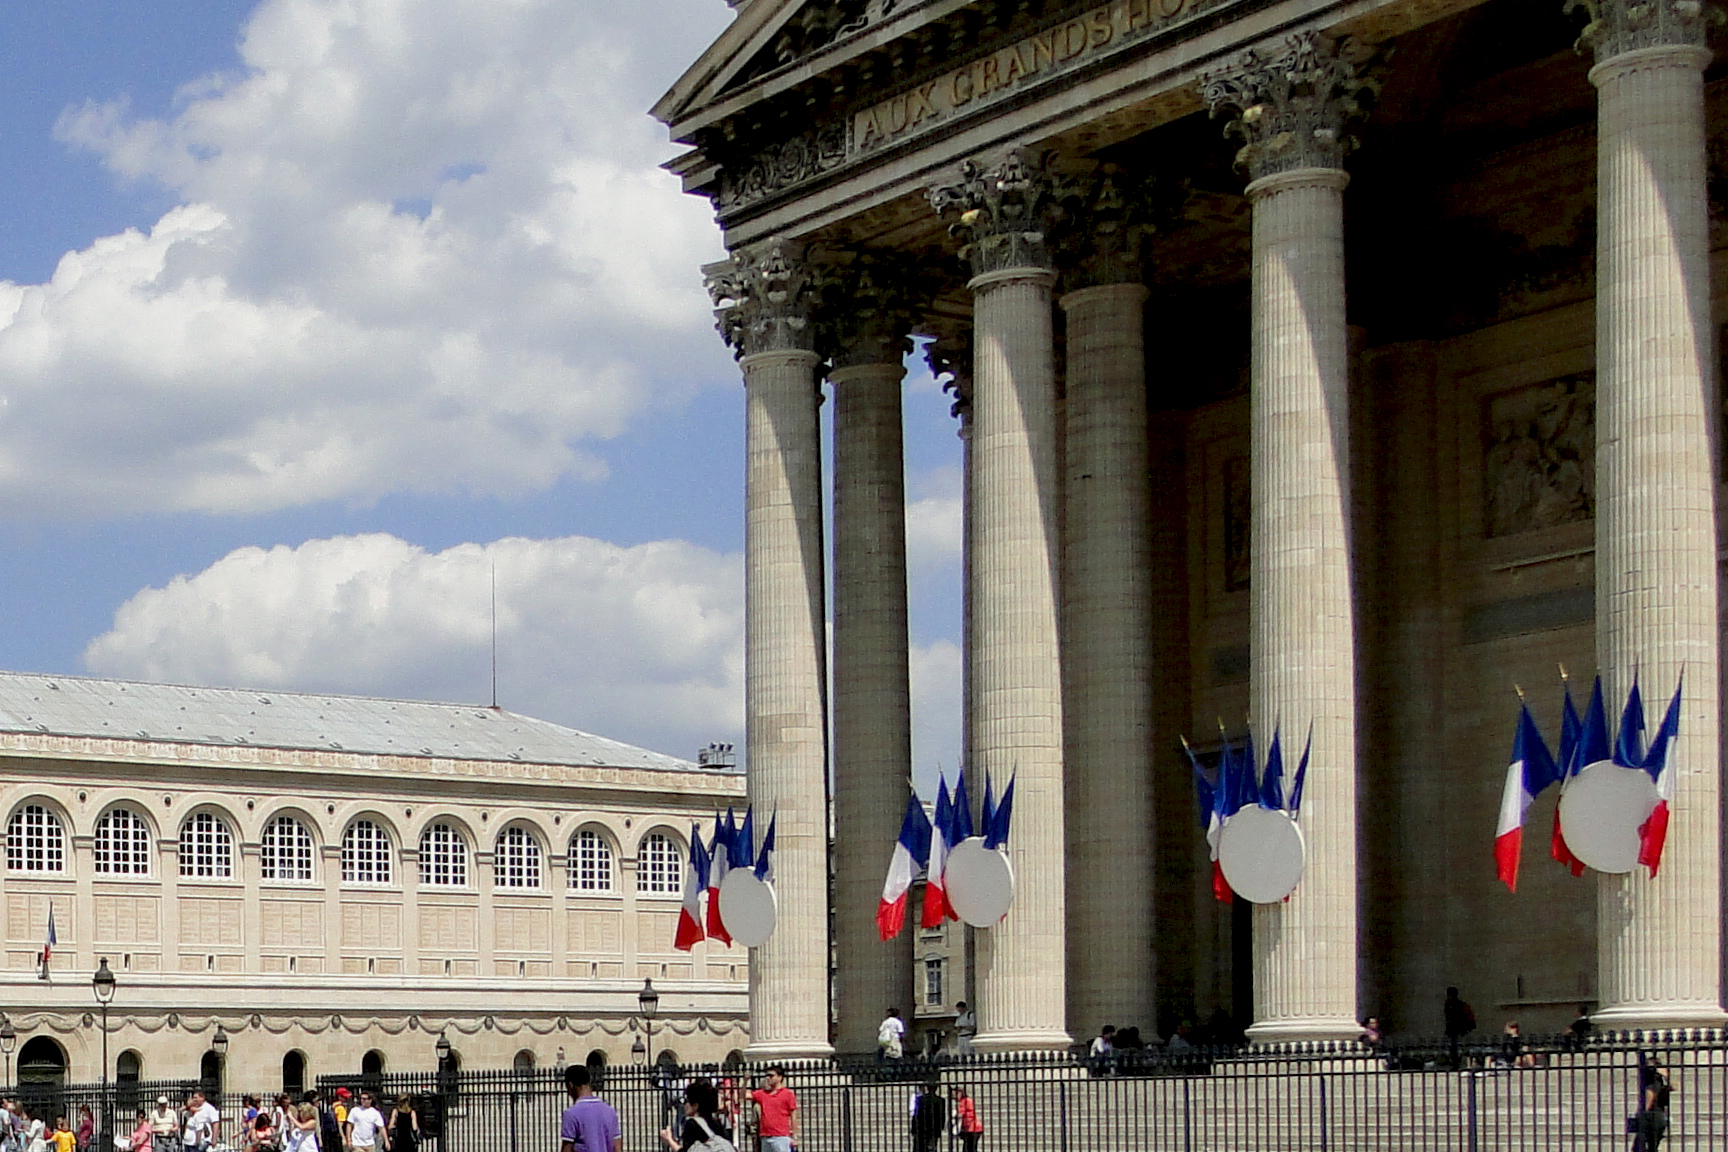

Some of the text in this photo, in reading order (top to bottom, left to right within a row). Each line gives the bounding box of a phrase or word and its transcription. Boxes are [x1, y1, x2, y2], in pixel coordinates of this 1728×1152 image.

[861, 0, 1200, 149] AUX GRANDS HO
